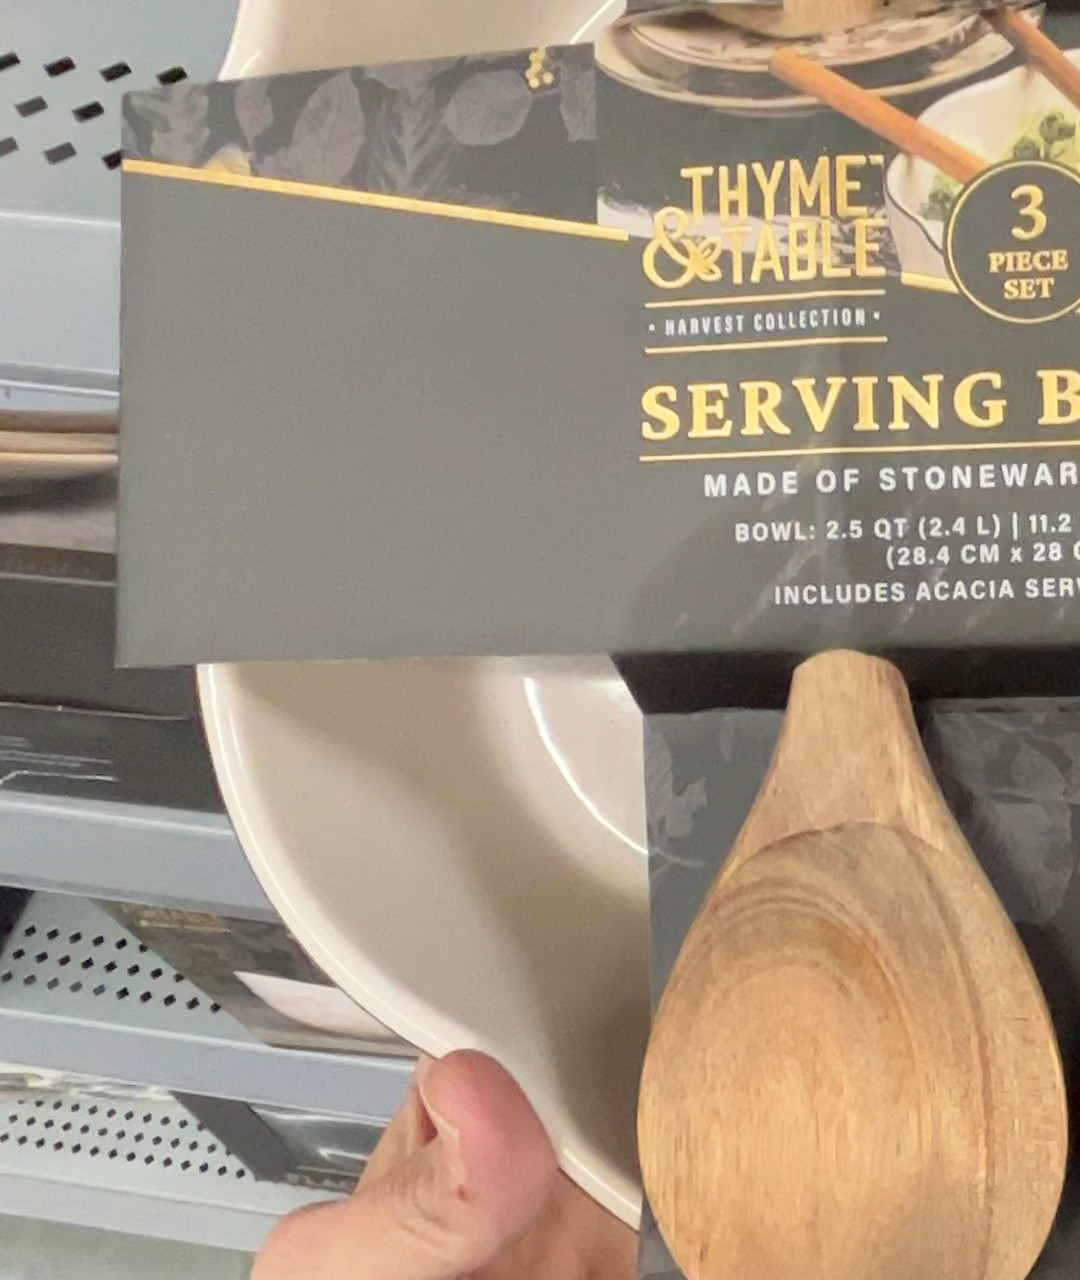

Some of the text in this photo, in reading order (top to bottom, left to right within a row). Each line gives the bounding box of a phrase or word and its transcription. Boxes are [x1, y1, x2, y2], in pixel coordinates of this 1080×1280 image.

[680, 155, 868, 223] THYME
[1011, 184, 1048, 241] 3
[720, 220, 887, 285] TABLE
[988, 249, 1069, 274] PIECE
[1003, 279, 1054, 300] SET
[665, 308, 867, 336] HARVEST COLLECTION
[640, 371, 1008, 441] SERVING
[704, 469, 799, 497] MADE
[816, 468, 861, 493] OF
[735, 521, 816, 543] BOWL:
[826, 521, 864, 540] 2.5
[874, 517, 907, 540] QT
[918, 515, 966, 541] (2.4
[976, 513, 1002, 539] L)
[1029, 511, 1072, 535] 11.2
[886, 544, 951, 570] (28.4
[961, 543, 1000, 564] CM
[1010, 546, 1023, 563] x
[1033, 542, 1062, 562] 28
[774, 581, 905, 606] INCLUDES
[915, 577, 1014, 602] ACACIA
